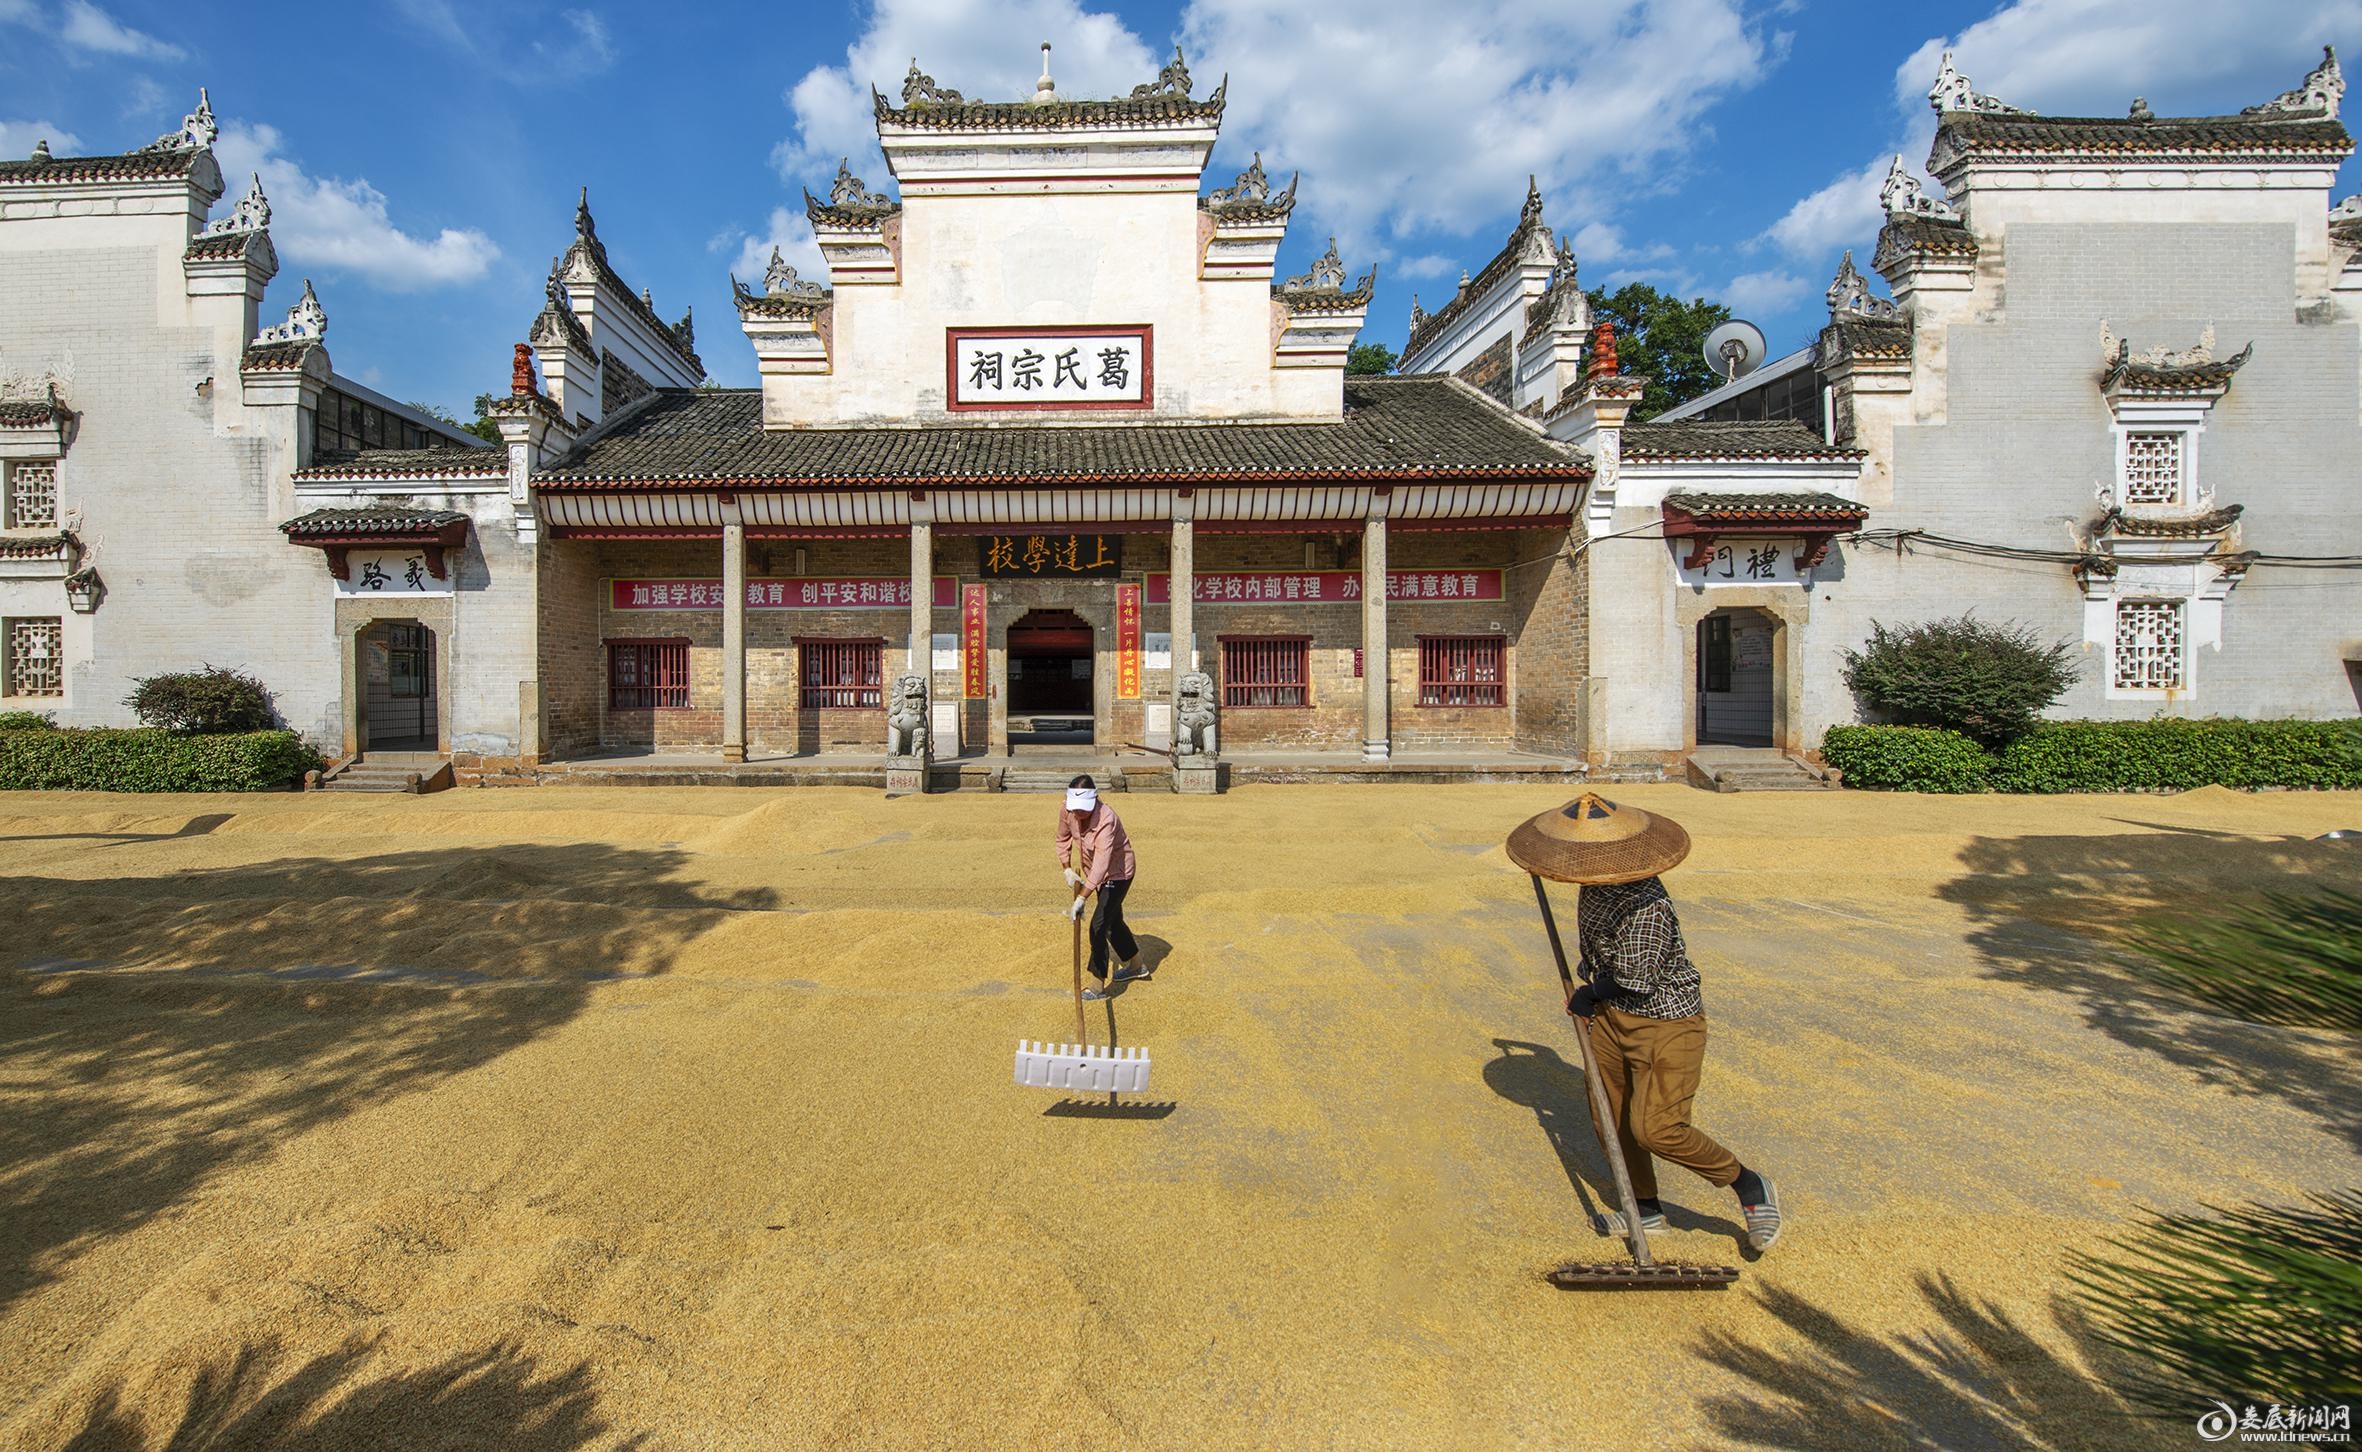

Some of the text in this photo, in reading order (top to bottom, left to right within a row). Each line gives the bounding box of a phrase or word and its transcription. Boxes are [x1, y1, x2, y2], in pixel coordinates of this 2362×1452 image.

[969, 347, 1130, 391] 葛氏宗祠
[632, 582, 935, 605] 加强学校安教育 创平安和谐校
[1167, 574, 1479, 600] 化学校内部管理 办民满意教育
